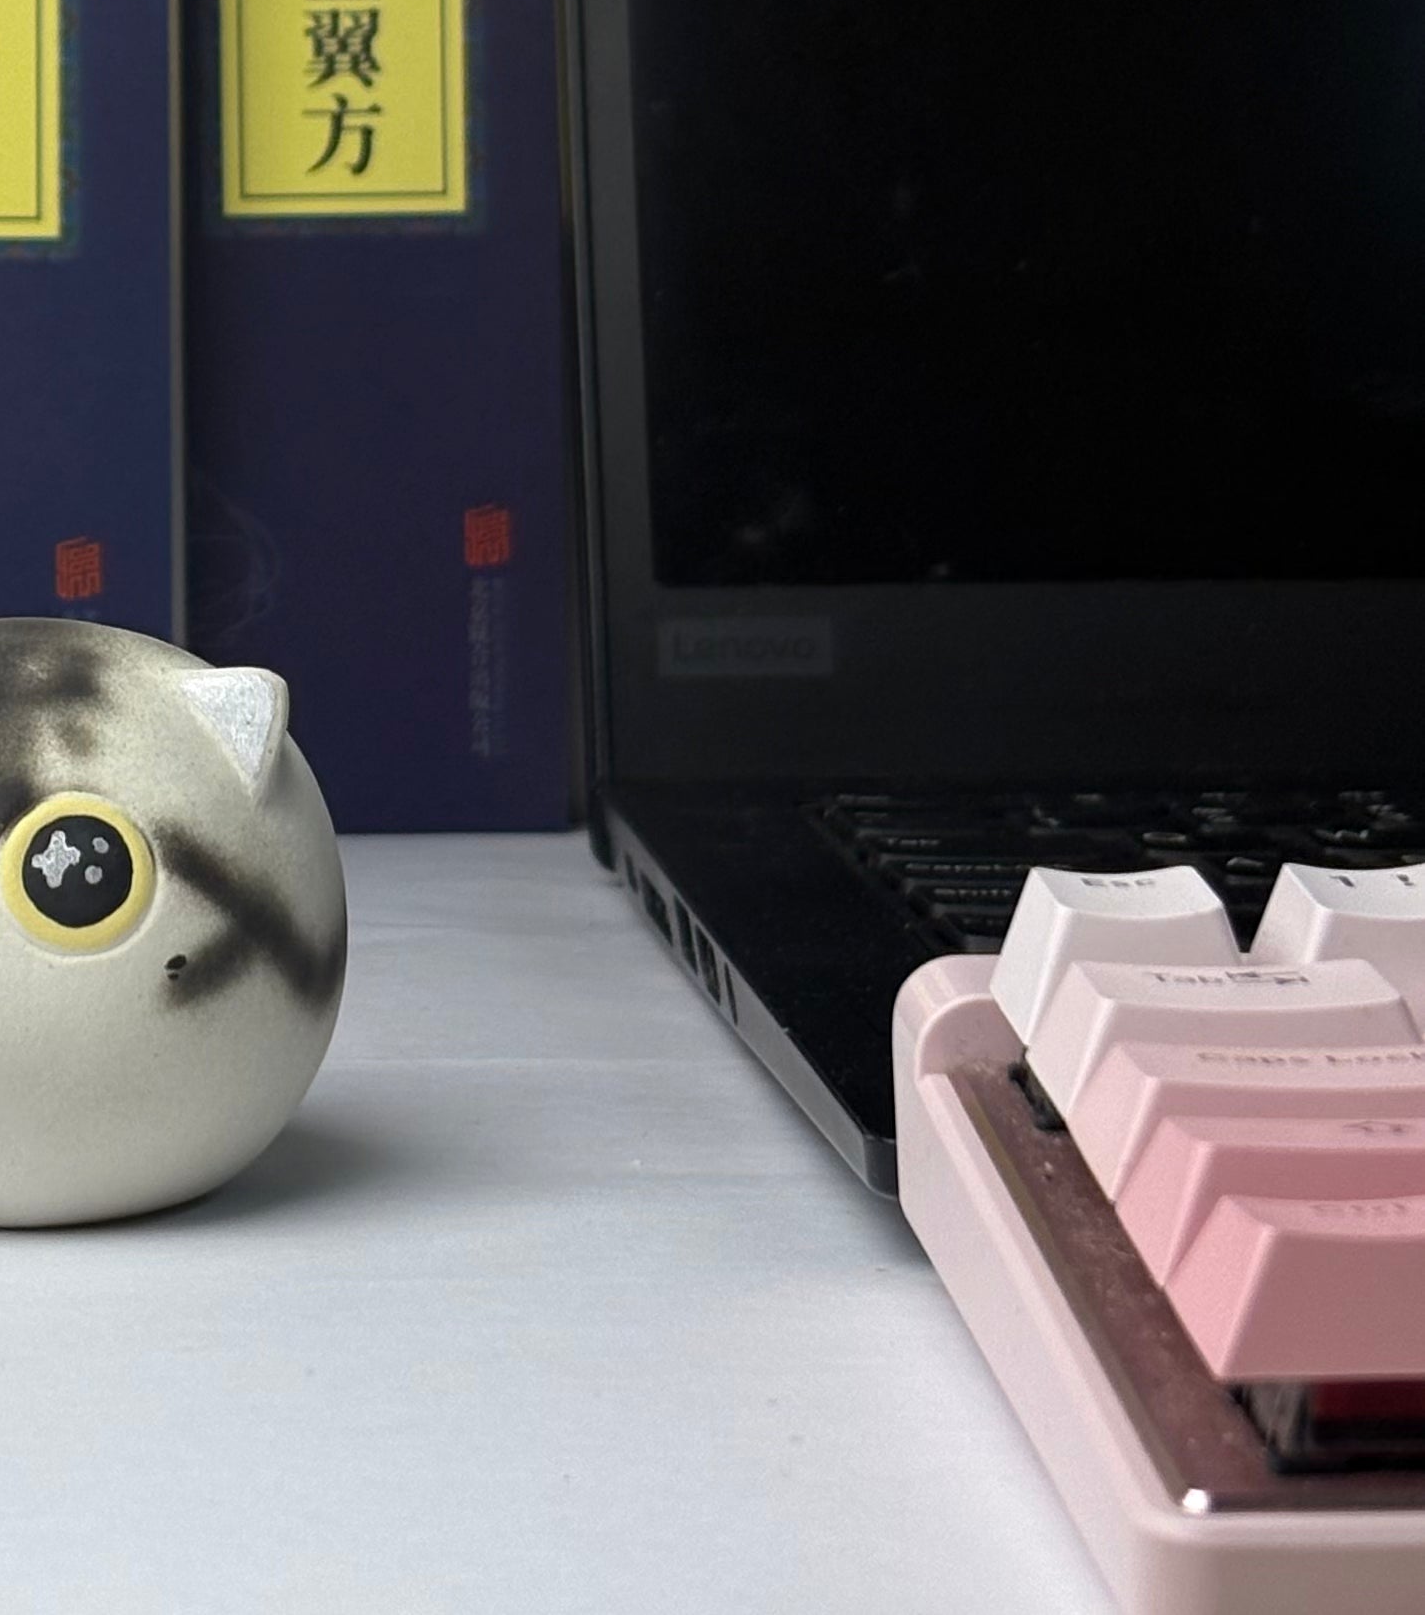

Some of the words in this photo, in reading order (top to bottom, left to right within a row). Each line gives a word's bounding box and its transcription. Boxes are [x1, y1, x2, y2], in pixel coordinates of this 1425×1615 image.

[672, 635, 817, 662] Lenovo
[1080, 876, 1157, 888] Esc
[1142, 970, 1224, 984] Tab
